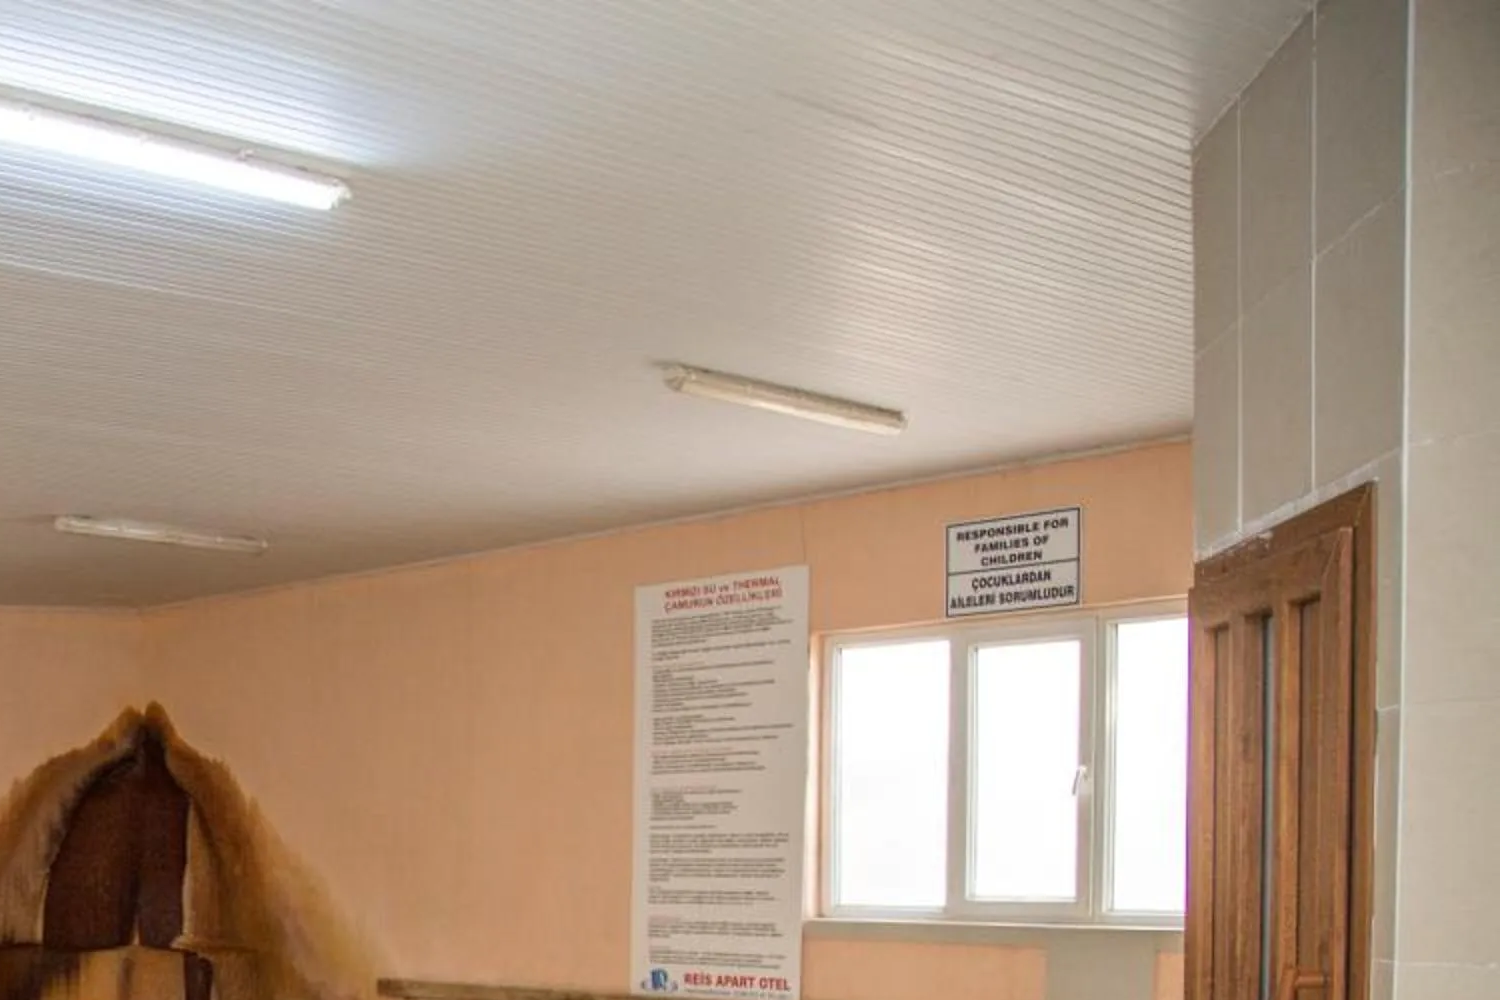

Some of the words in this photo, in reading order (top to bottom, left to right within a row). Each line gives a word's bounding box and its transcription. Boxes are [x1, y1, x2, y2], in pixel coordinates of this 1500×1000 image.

[956, 523, 1041, 541] RESPONSIBLE
[1044, 517, 1069, 530] FOR
[974, 538, 1029, 553] FAMILIES
[1033, 534, 1050, 545] OF
[981, 551, 1043, 566] CHILDREN
[704, 584, 717, 596] SU
[971, 571, 1051, 591] ÇOCUKLARDAN
[999, 586, 1075, 605] SORUMLUDUR
[683, 971, 713, 985] REİS
[716, 974, 754, 988] APART
[759, 976, 791, 991] OTEL
